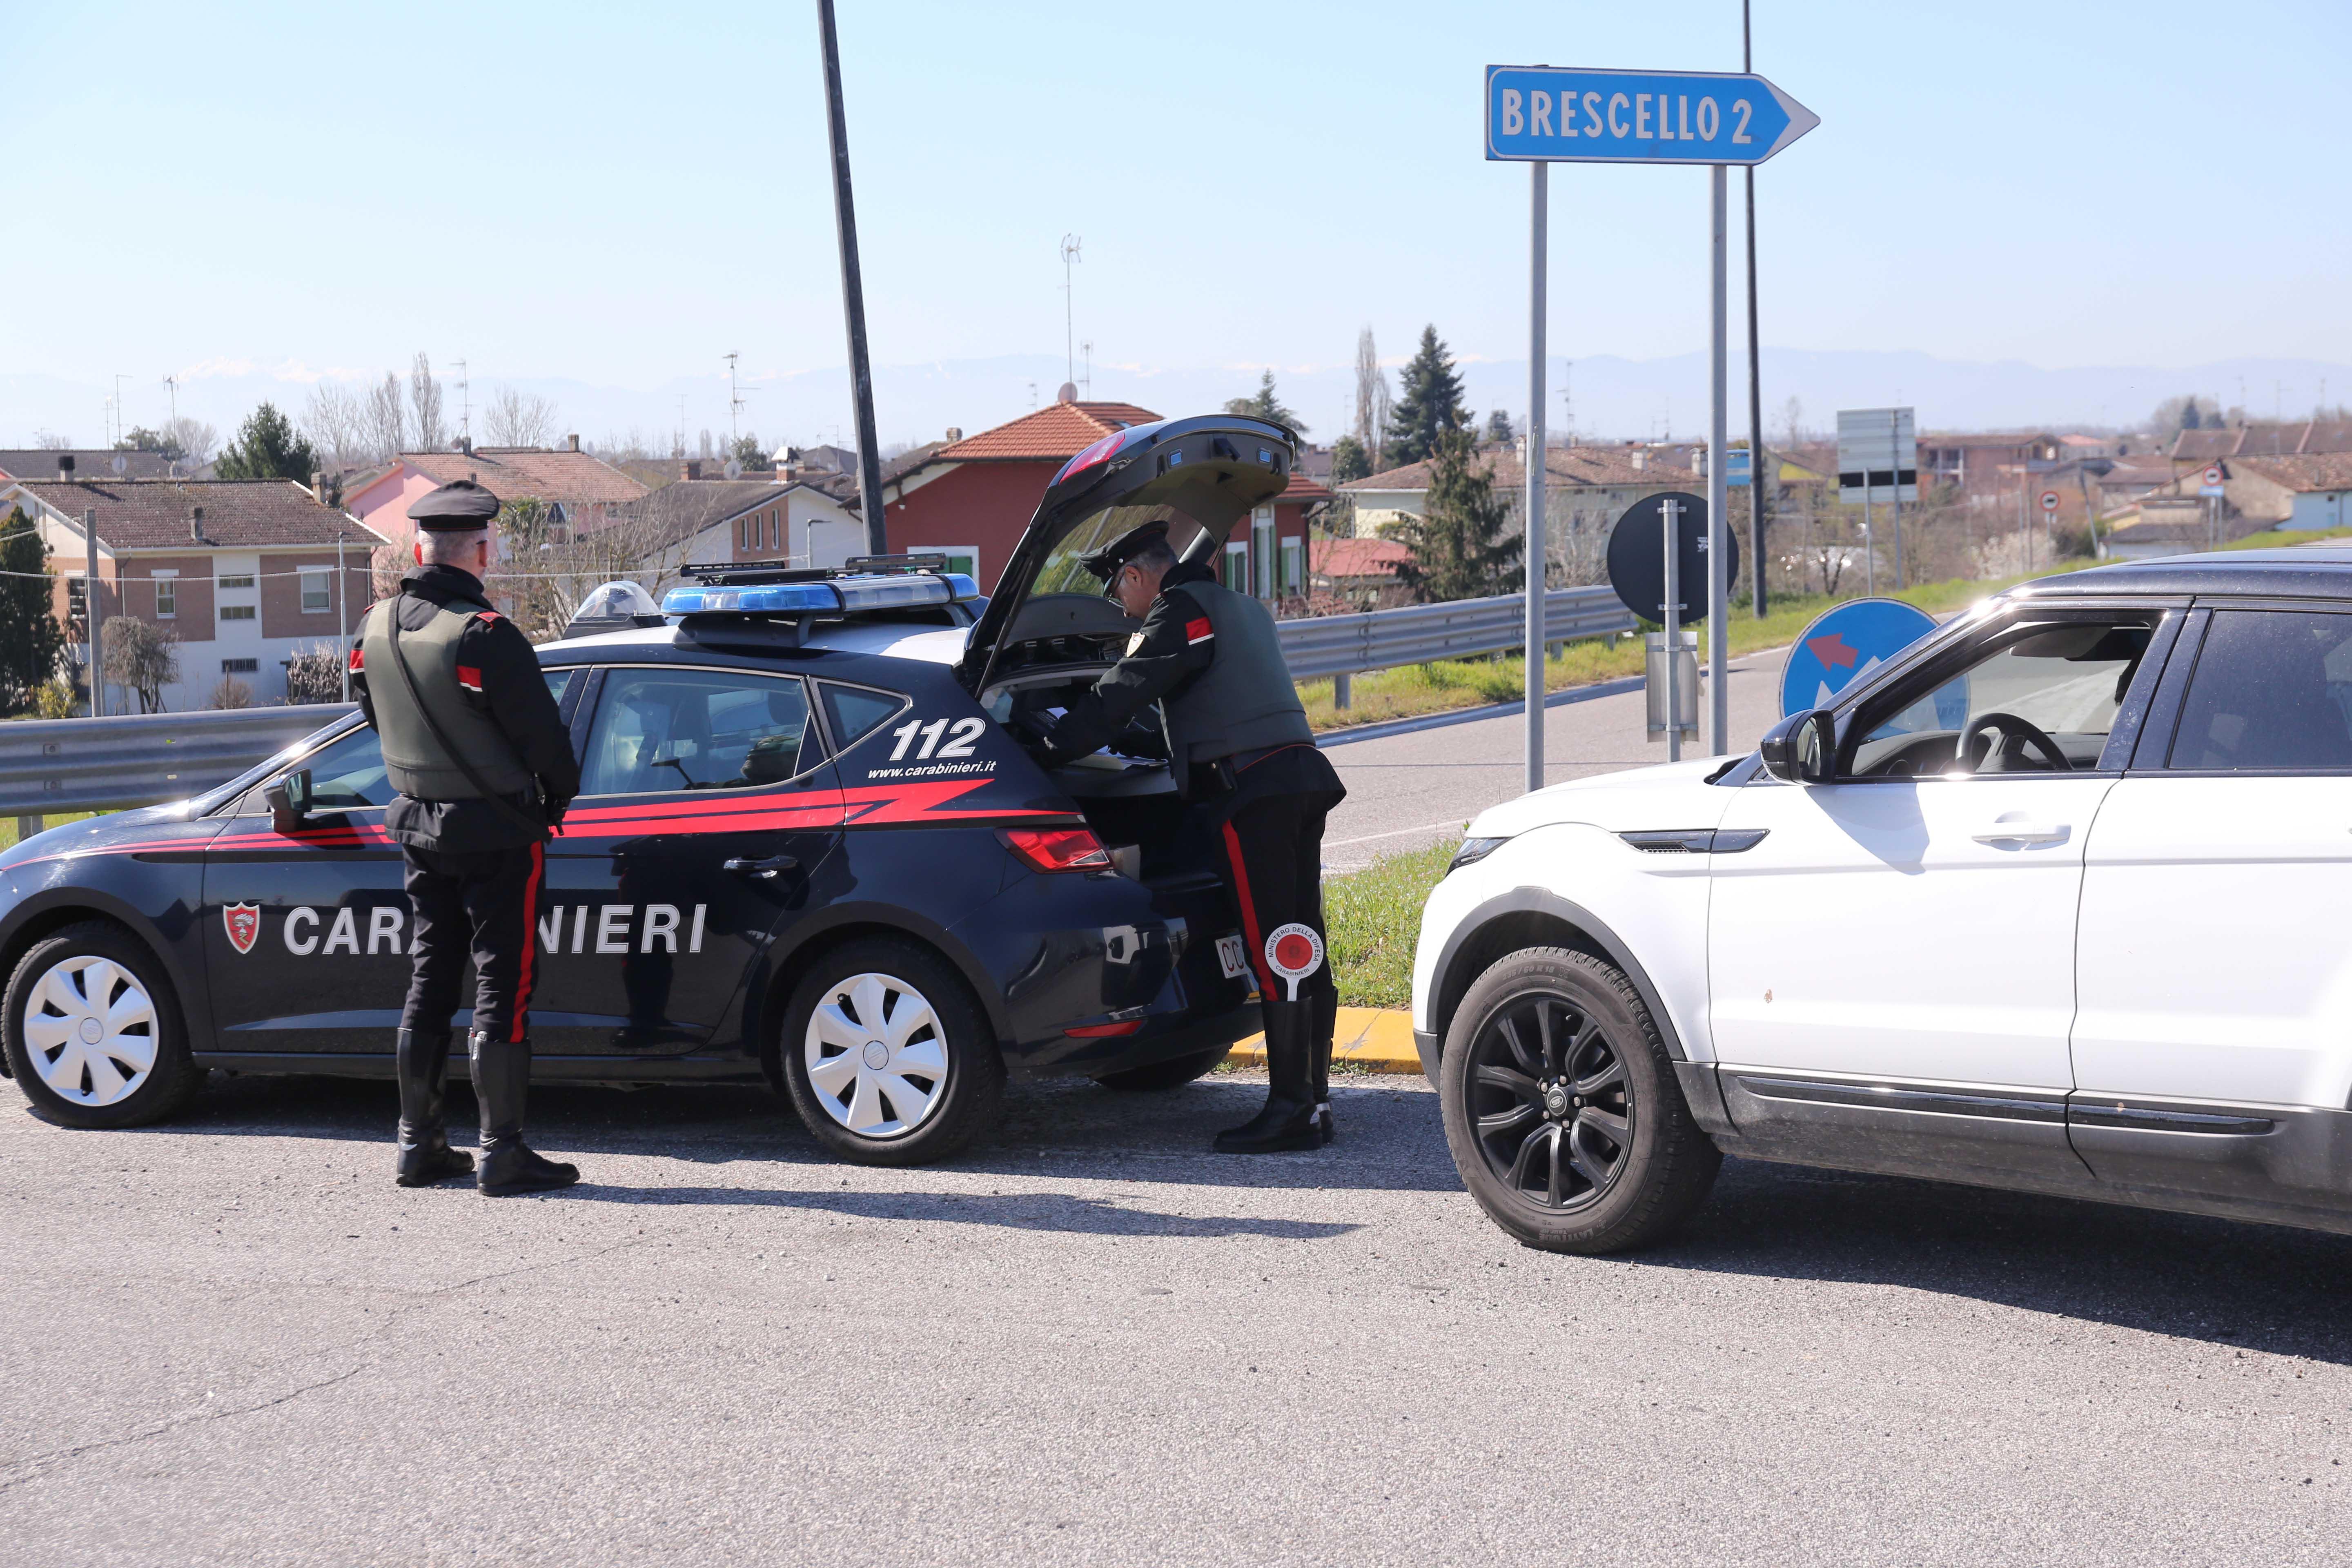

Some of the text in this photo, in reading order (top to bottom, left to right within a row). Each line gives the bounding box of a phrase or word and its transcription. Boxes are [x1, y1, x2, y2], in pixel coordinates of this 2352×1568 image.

[1502, 88, 1752, 144] BRESCELLO 2
[889, 717, 986, 761] 112
[867, 761, 997, 779] www.carabinieri.it
[284, 904, 707, 956] CARNIERI
[1268, 927, 1320, 962] MINISTERO DELLA DIFESA
[1221, 940, 1244, 972] CC
[1275, 965, 1310, 976] CARABINIERI
